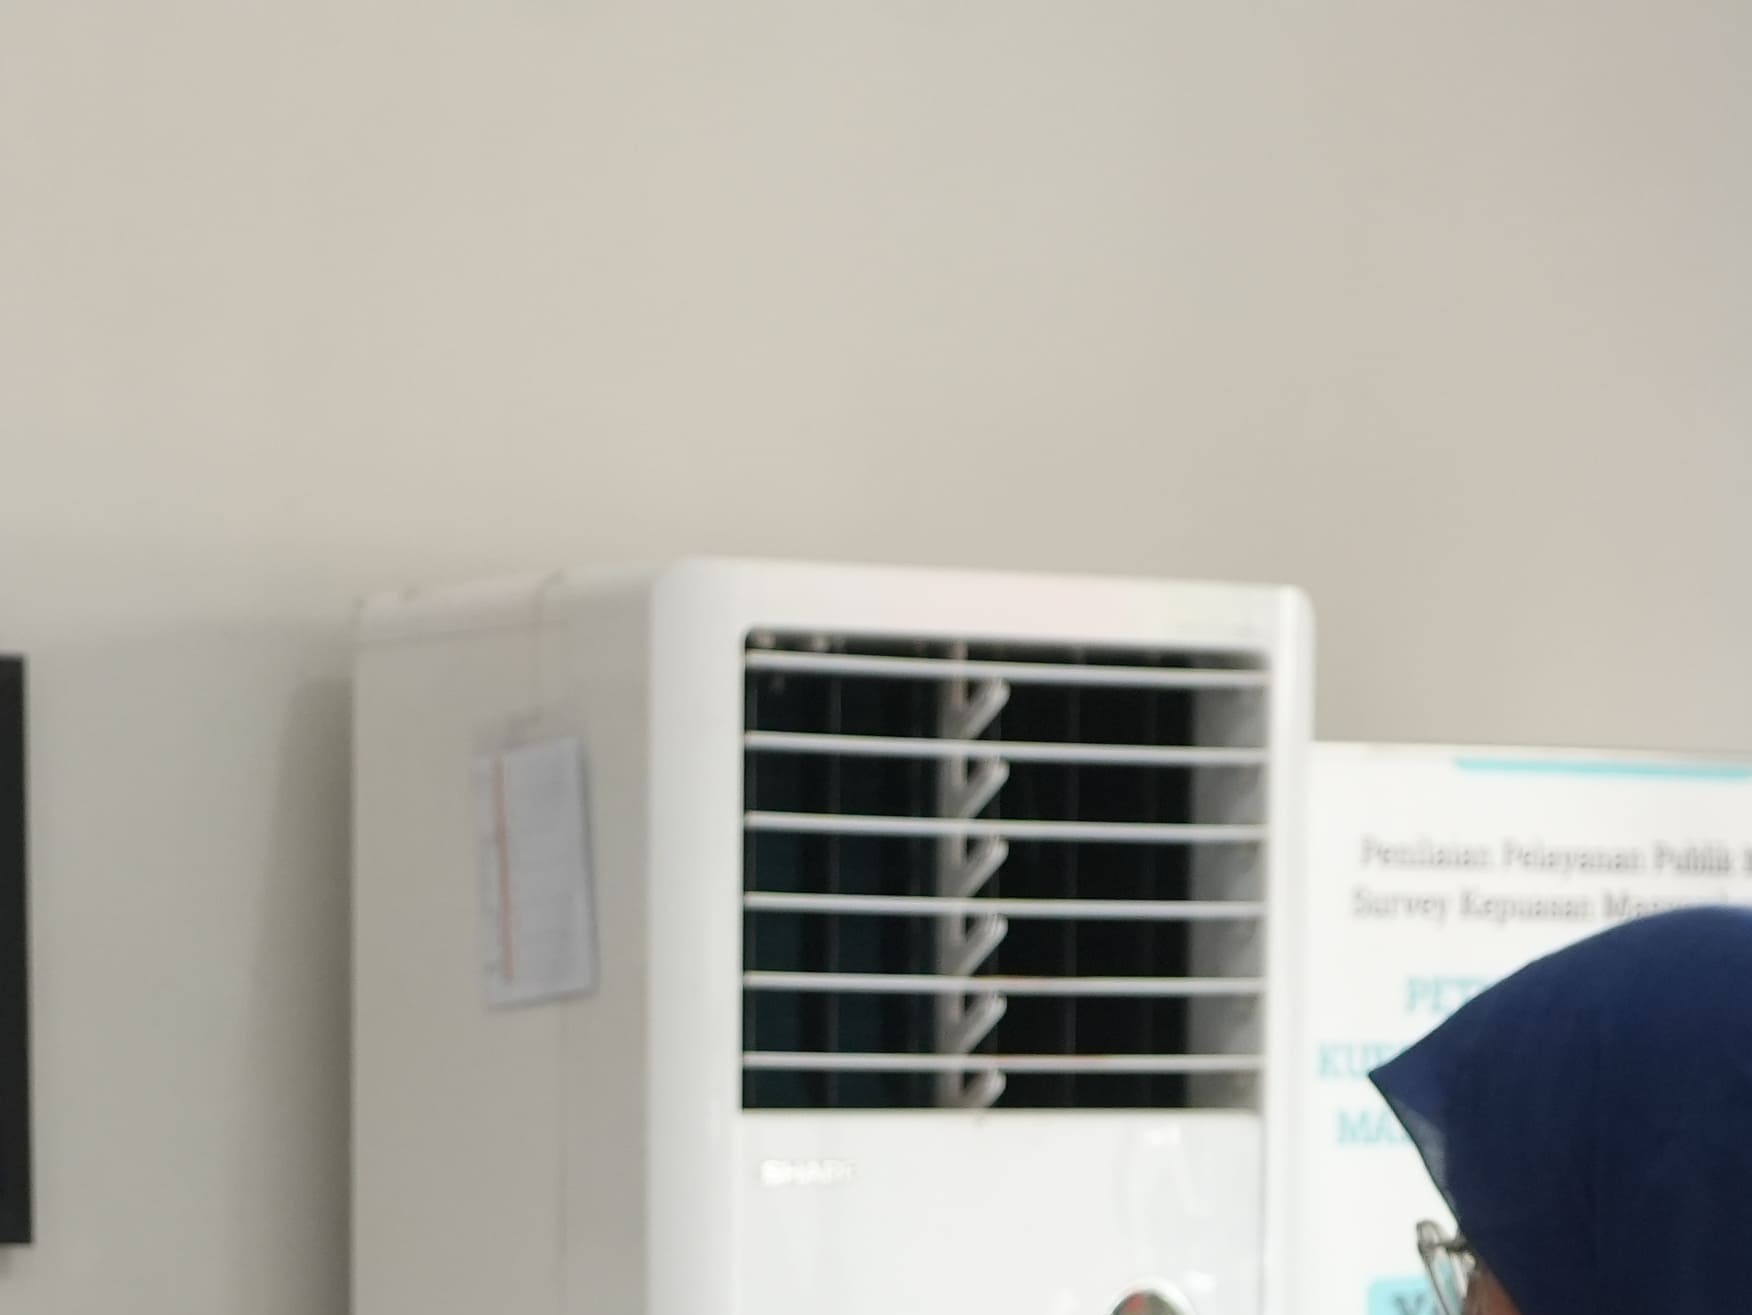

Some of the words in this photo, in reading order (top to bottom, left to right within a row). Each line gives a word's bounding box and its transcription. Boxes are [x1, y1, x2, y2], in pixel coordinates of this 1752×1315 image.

[1502, 837, 1642, 878] Pelayanan
[1653, 841, 1732, 874] Publik
[1352, 888, 1450, 926] Survey
[1460, 890, 1589, 926] Kepuasan
